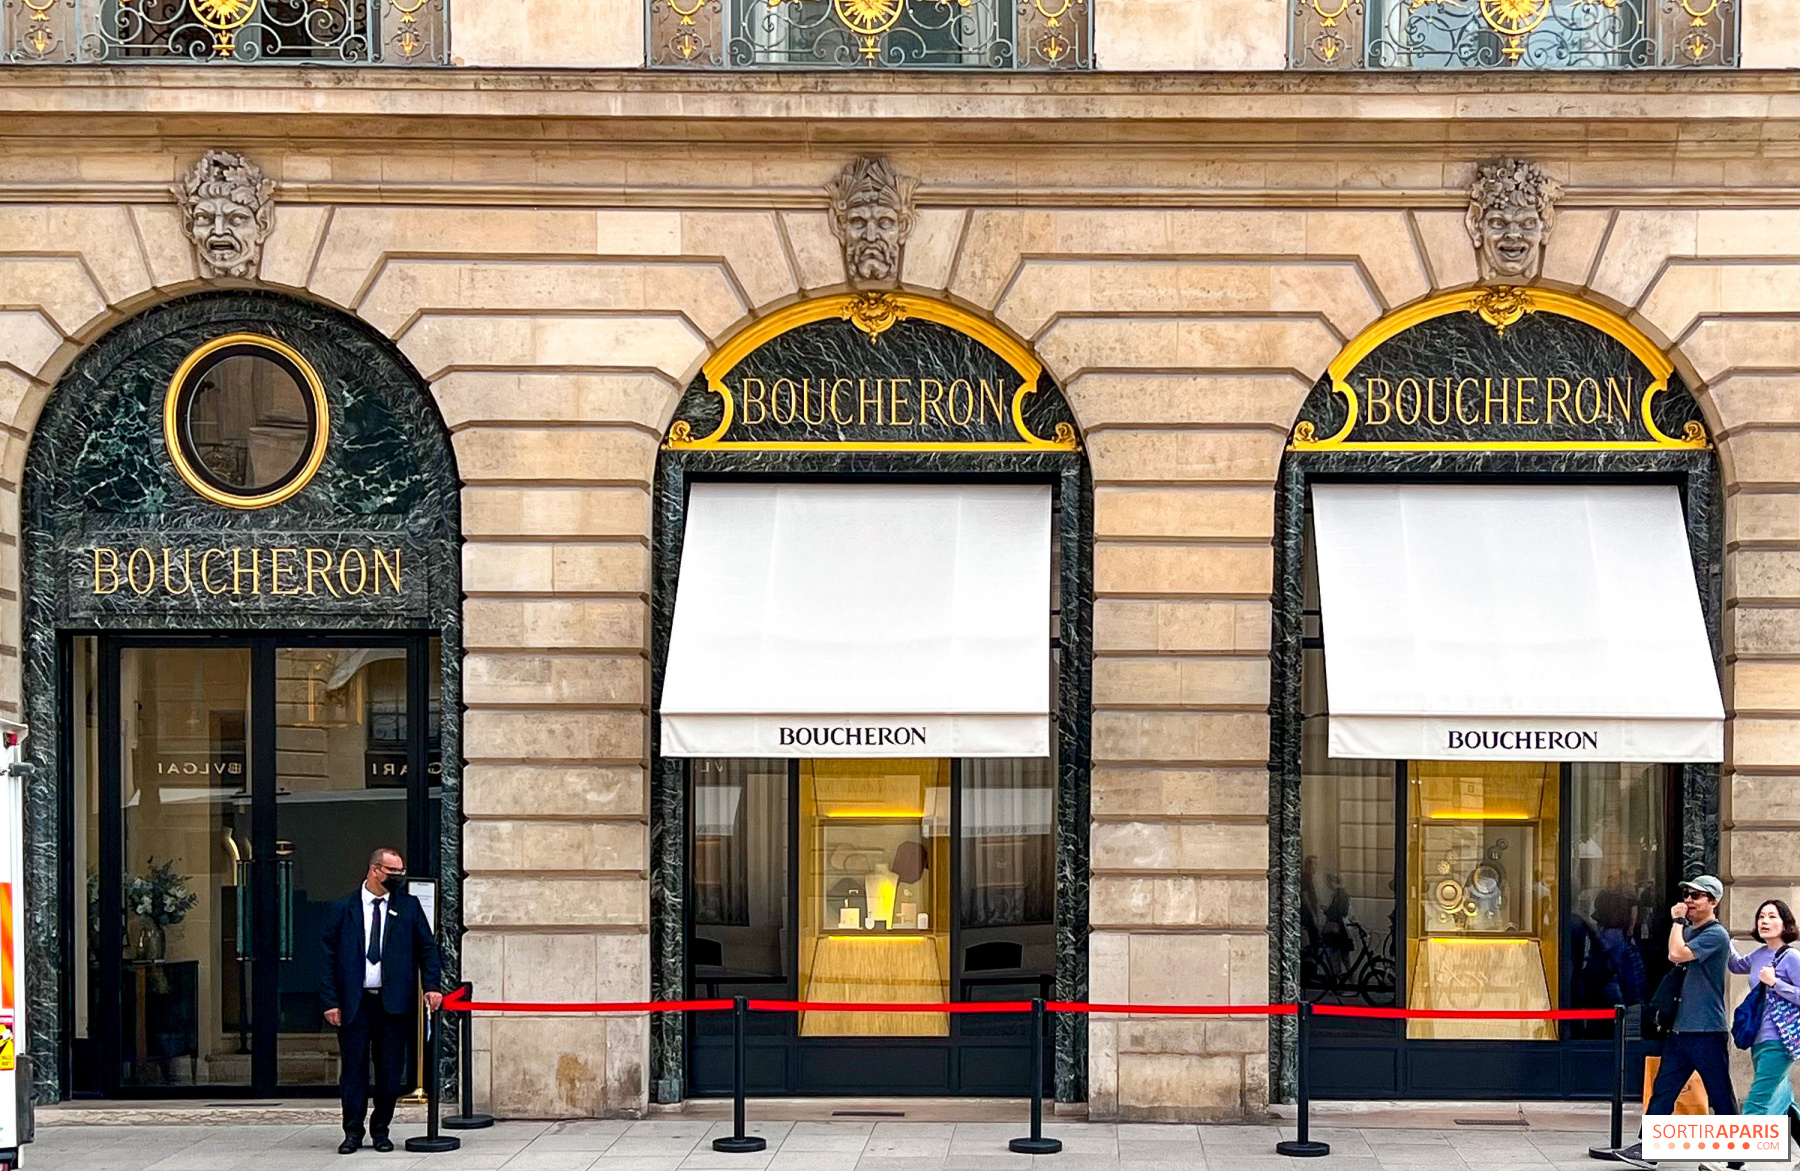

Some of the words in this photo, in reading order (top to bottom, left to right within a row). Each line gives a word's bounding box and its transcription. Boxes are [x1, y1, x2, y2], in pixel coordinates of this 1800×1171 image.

[742, 378, 1004, 426] BOUCHERON
[1365, 377, 1633, 425] BOUCHERON
[93, 548, 401, 598] BOUCHERON
[779, 726, 927, 746] BOUCHERON
[1448, 730, 1598, 750] BOUCHERON
